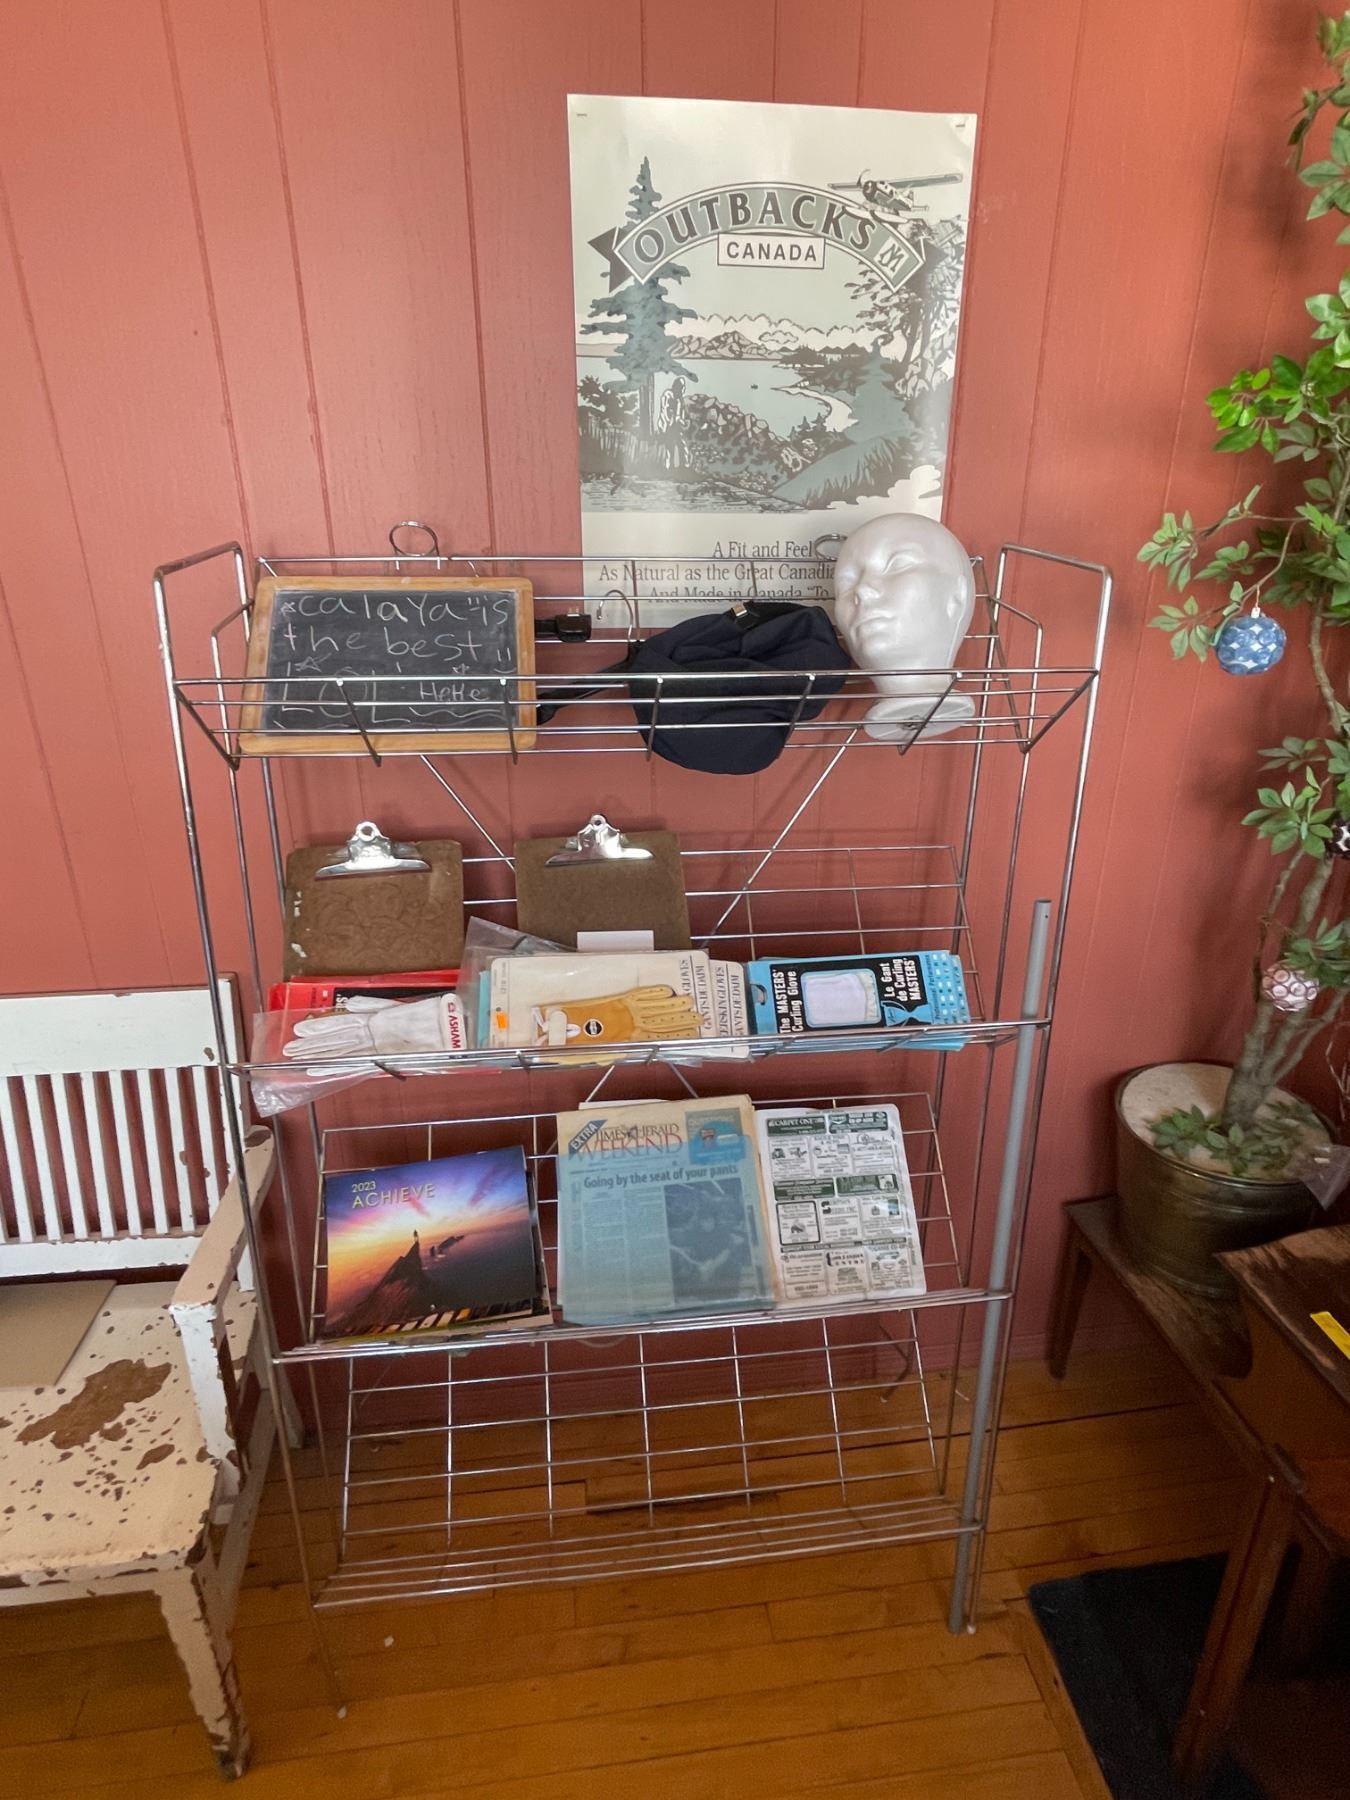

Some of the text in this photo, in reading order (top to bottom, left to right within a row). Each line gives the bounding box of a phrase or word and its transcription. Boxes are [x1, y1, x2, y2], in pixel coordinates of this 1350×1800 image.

[633, 191, 878, 265] OUTBACKS
[726, 241, 818, 263] CANADA
[712, 541, 812, 558] A Fit and Feel
[599, 562, 836, 581] As Natural as the Great Canadia
[880, 962, 896, 998] Le Gant
[892, 958, 908, 1001] de Curling
[902, 957, 922, 1000] MASTERS'
[772, 969, 791, 1034] The MASTERS'
[787, 970, 804, 1032] Curling Glove
[448, 1015, 462, 1049] ASHAM
[570, 1122, 598, 1150] EXTRA
[352, 1181, 377, 1193] 2023
[584, 1164, 738, 1190] Going by the seat of your pants
[352, 1184, 435, 1209] ACHIEVE
